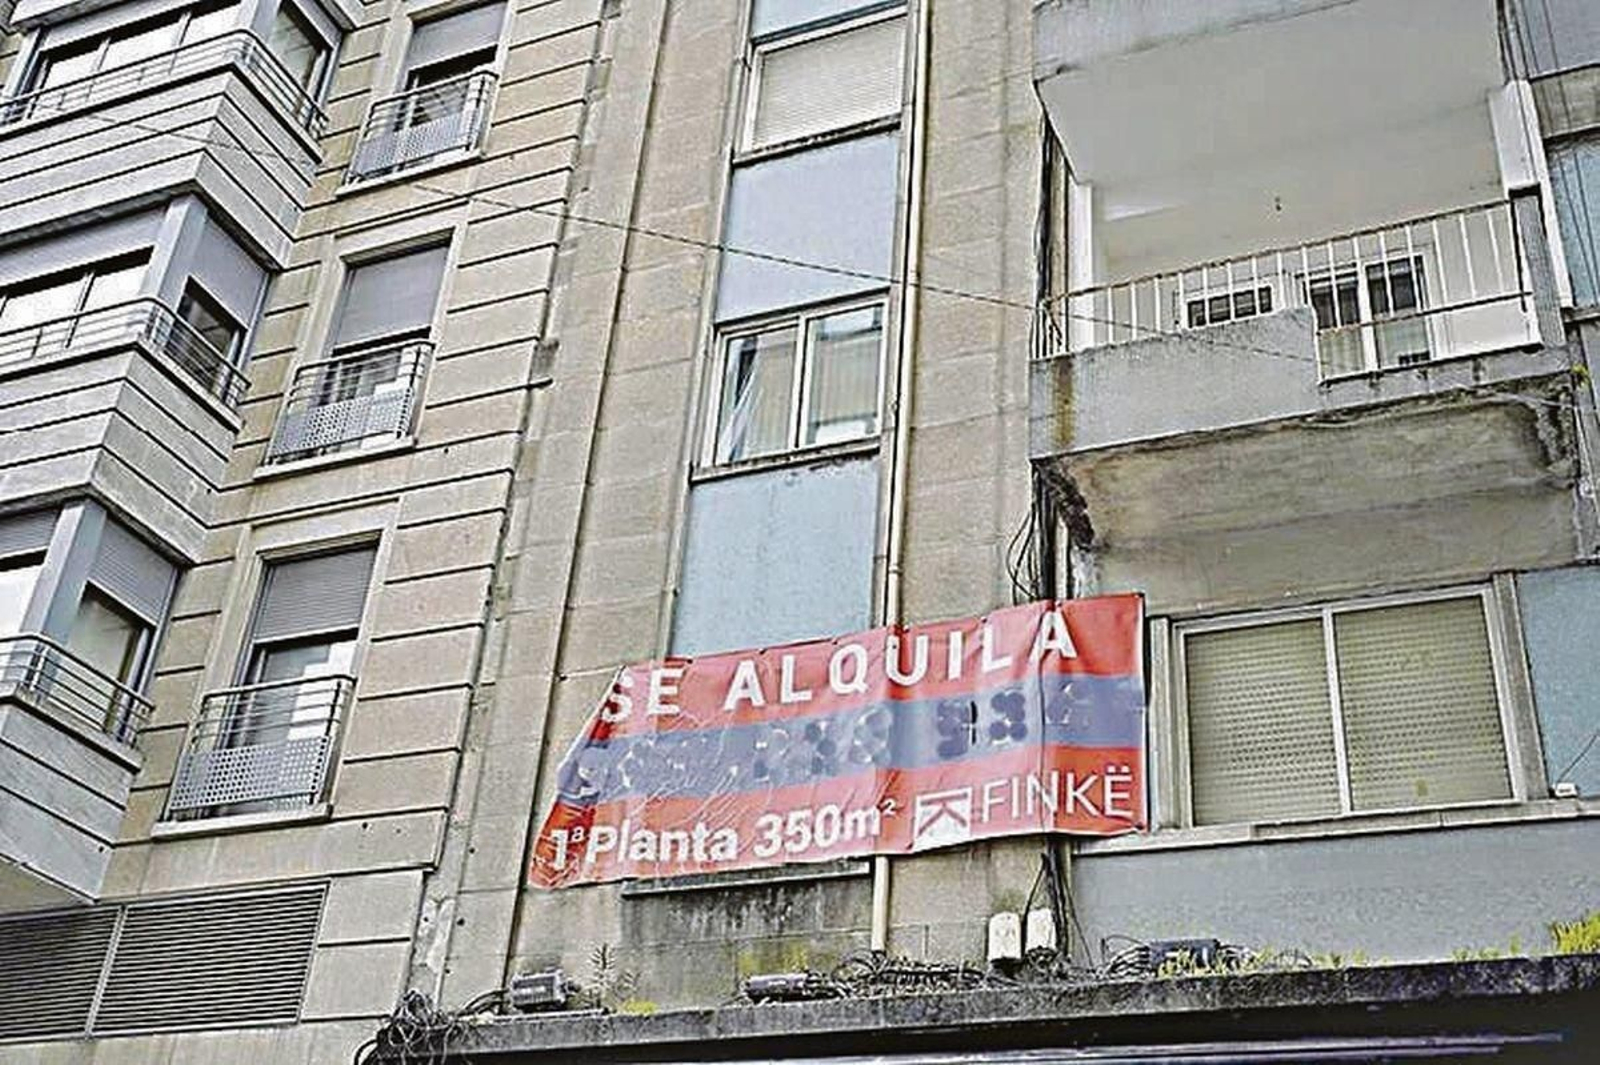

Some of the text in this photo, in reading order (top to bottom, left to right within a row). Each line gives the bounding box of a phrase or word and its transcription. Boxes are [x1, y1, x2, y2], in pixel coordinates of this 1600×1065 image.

[602, 608, 1078, 723] SE ALQUILA
[981, 764, 1133, 823] FINKË
[584, 817, 739, 866] Planta
